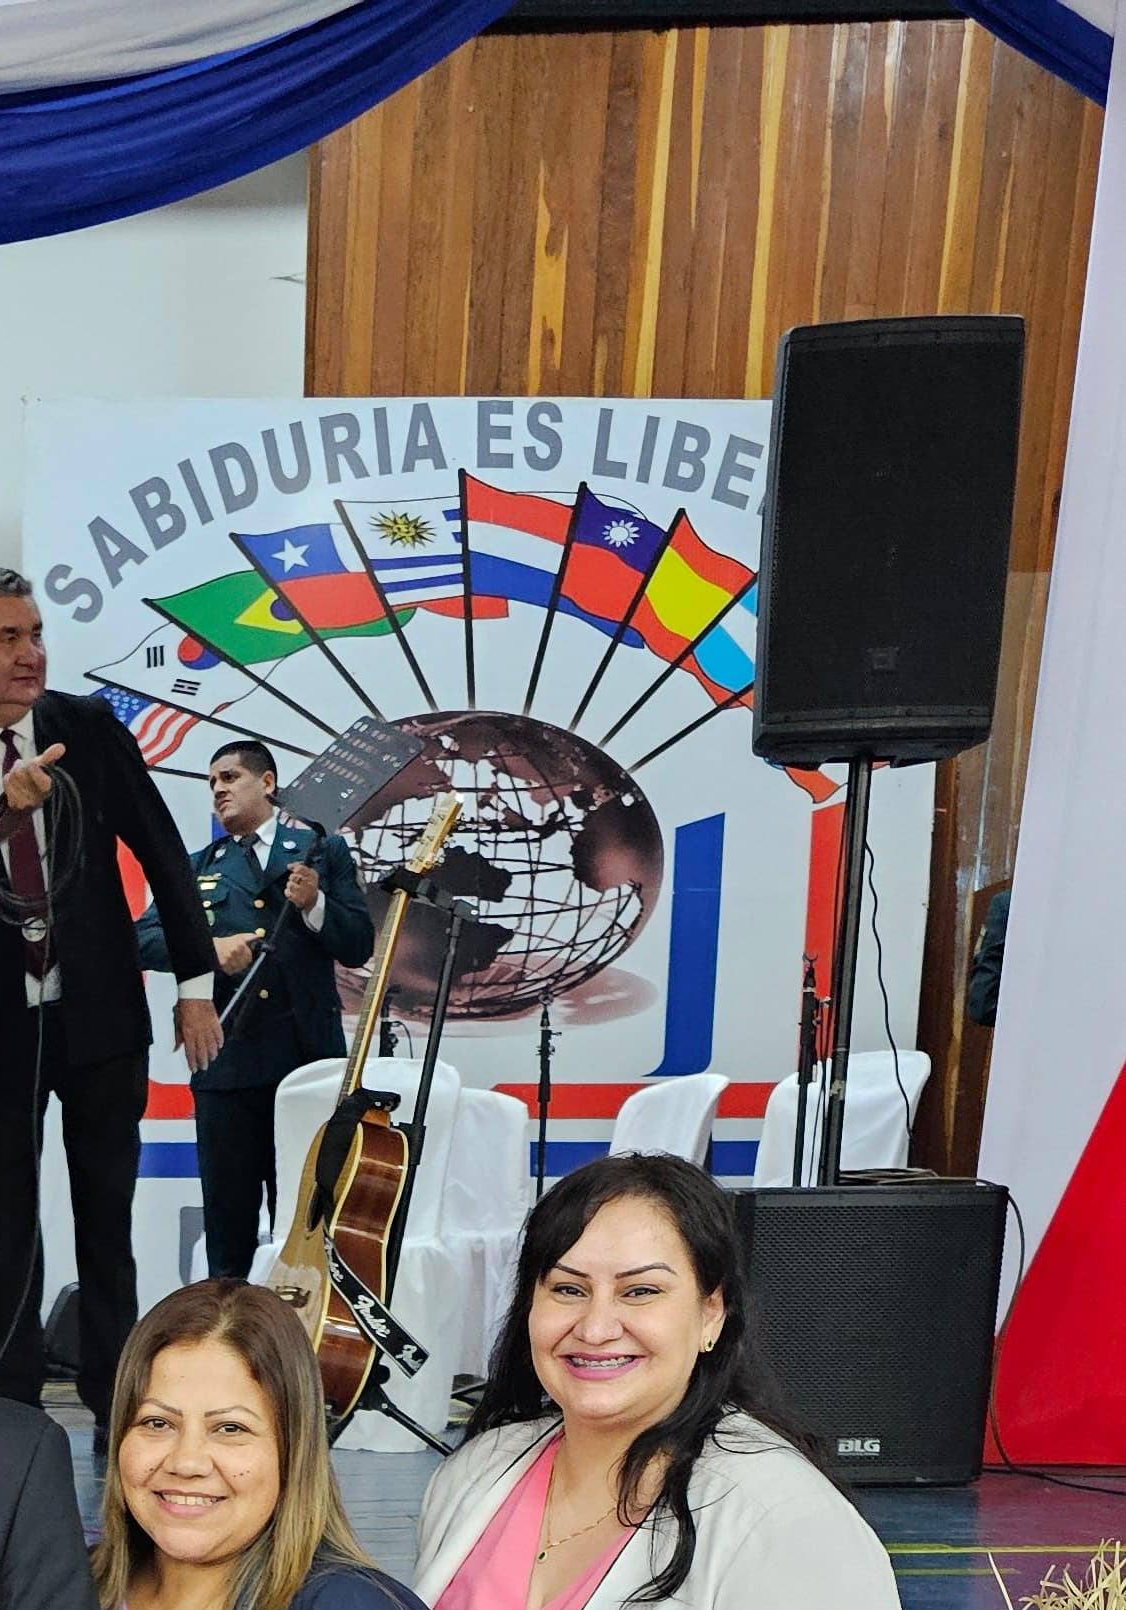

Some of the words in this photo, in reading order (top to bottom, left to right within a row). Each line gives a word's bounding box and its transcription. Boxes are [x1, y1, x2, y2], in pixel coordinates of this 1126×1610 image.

[44, 402, 449, 624] SABIDURIA
[476, 399, 564, 472] ES
[591, 407, 766, 517] LIBE
[837, 1437, 881, 1453] BLG
